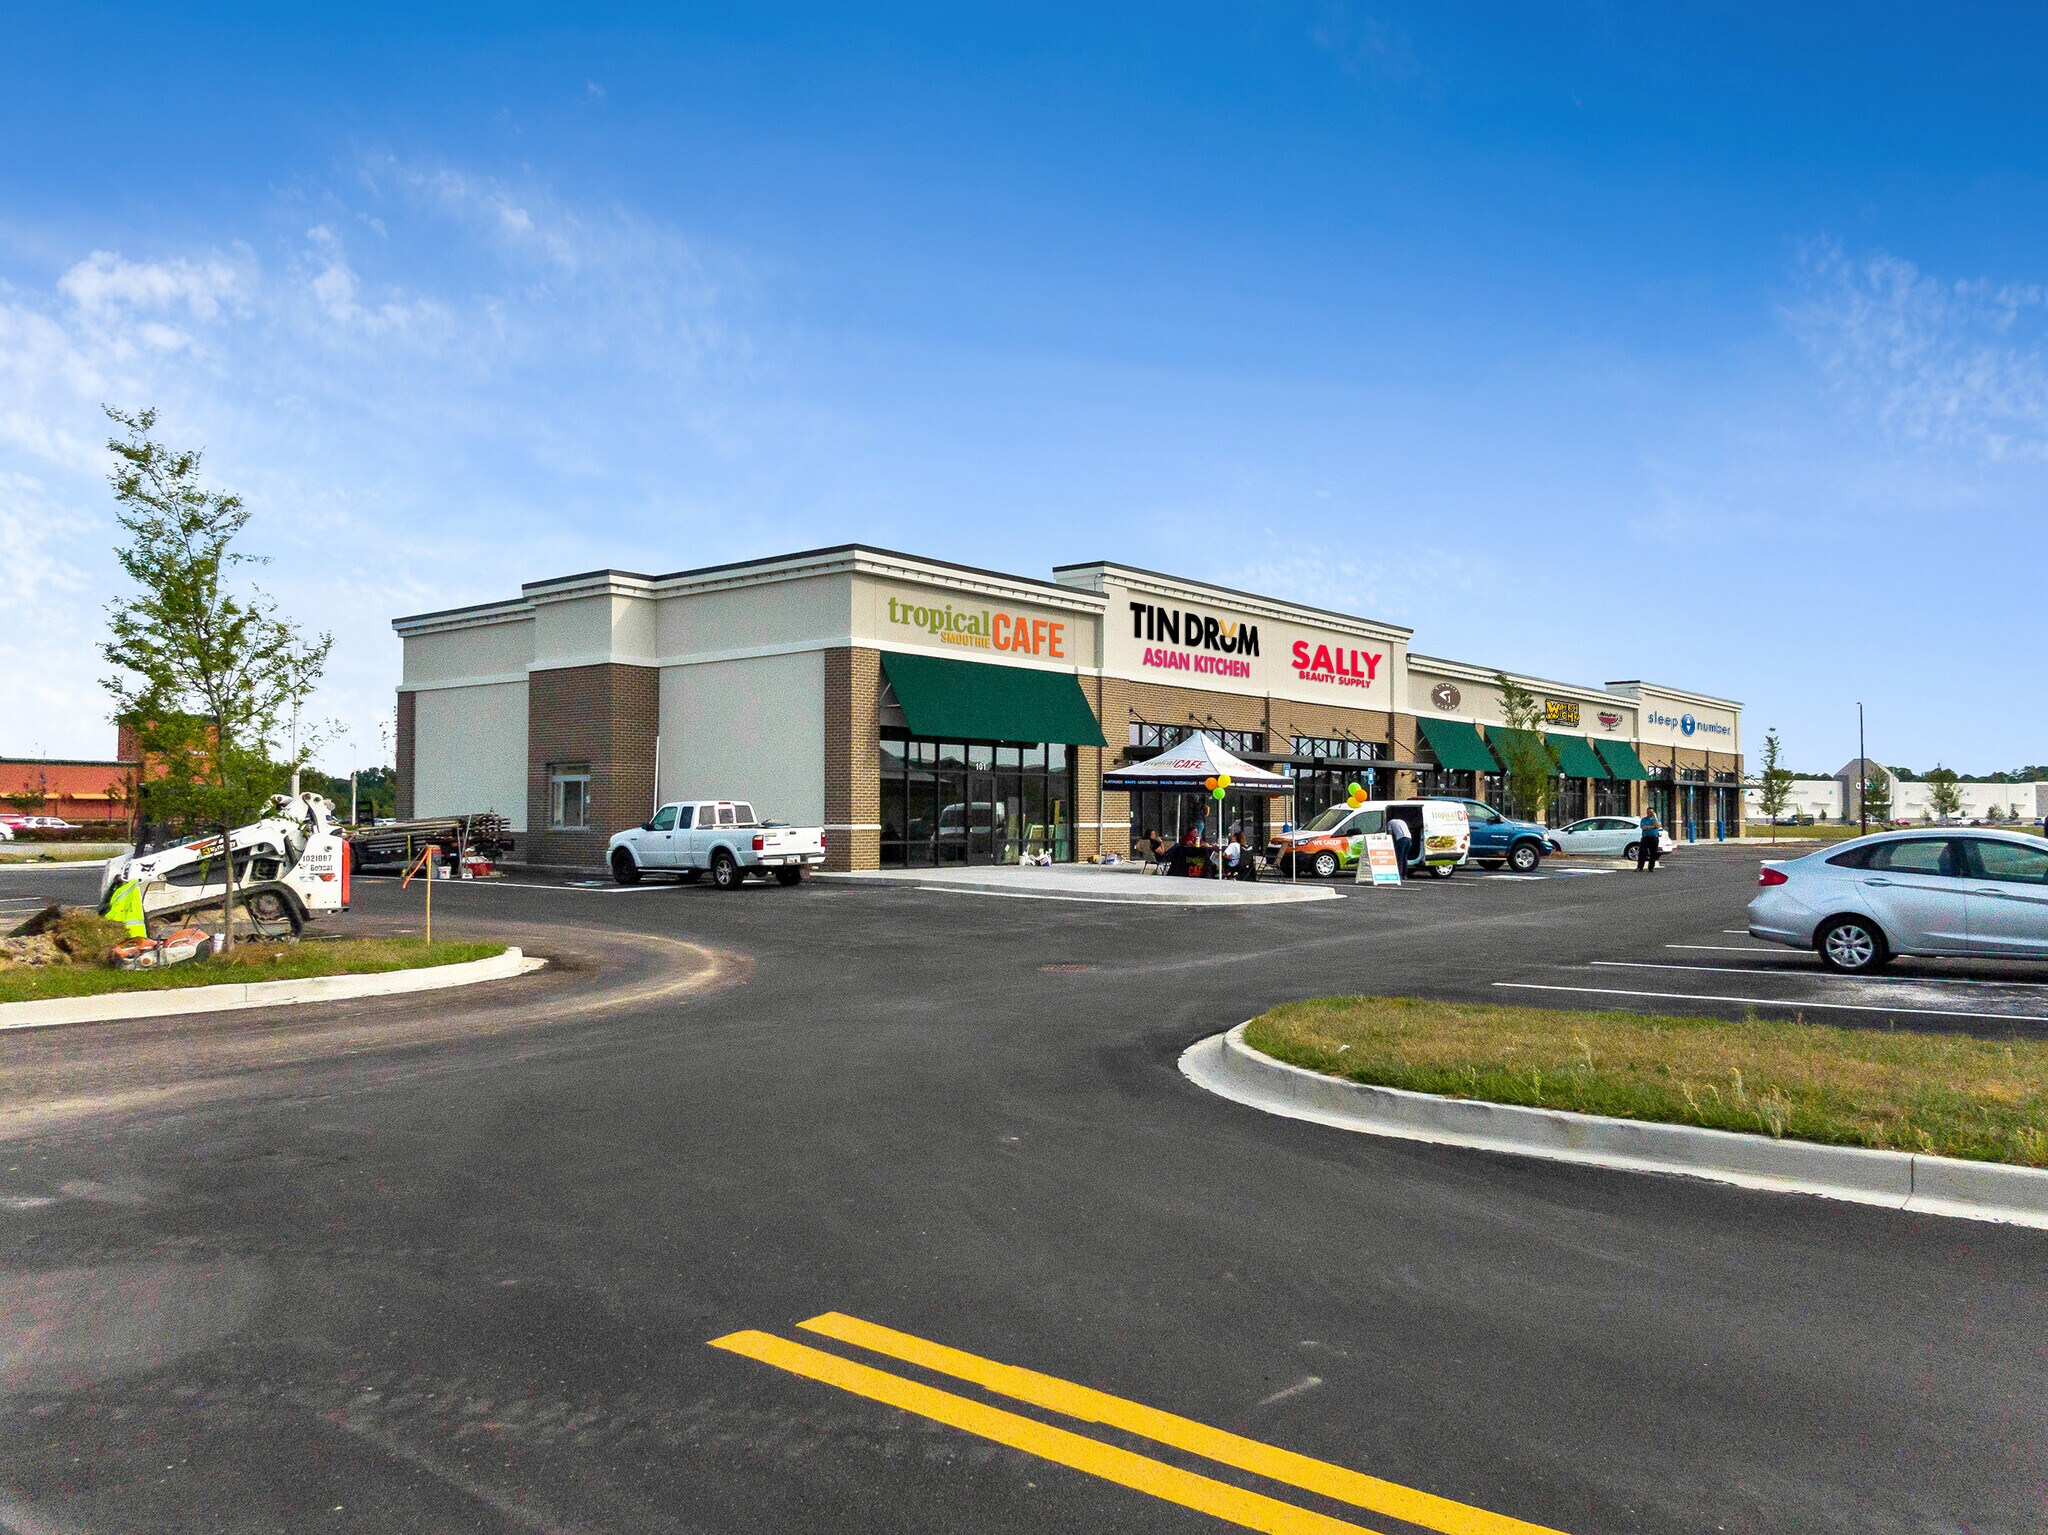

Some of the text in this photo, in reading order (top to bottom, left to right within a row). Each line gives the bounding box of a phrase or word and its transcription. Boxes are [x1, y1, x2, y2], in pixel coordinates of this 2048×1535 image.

[888, 597, 1065, 658] tropical CAFE
[1130, 601, 1260, 657] TIN DRUM
[941, 631, 991, 649] SMOOTHIE
[1143, 647, 1250, 678] ASIAN KITCHEN
[1291, 640, 1383, 680] SALLY
[1299, 670, 1372, 689] BEAUTY SUPPLY
[1648, 711, 1731, 735] sleep number
[1173, 760, 1208, 769] CAFE
[303, 854, 332, 862] 1021087
